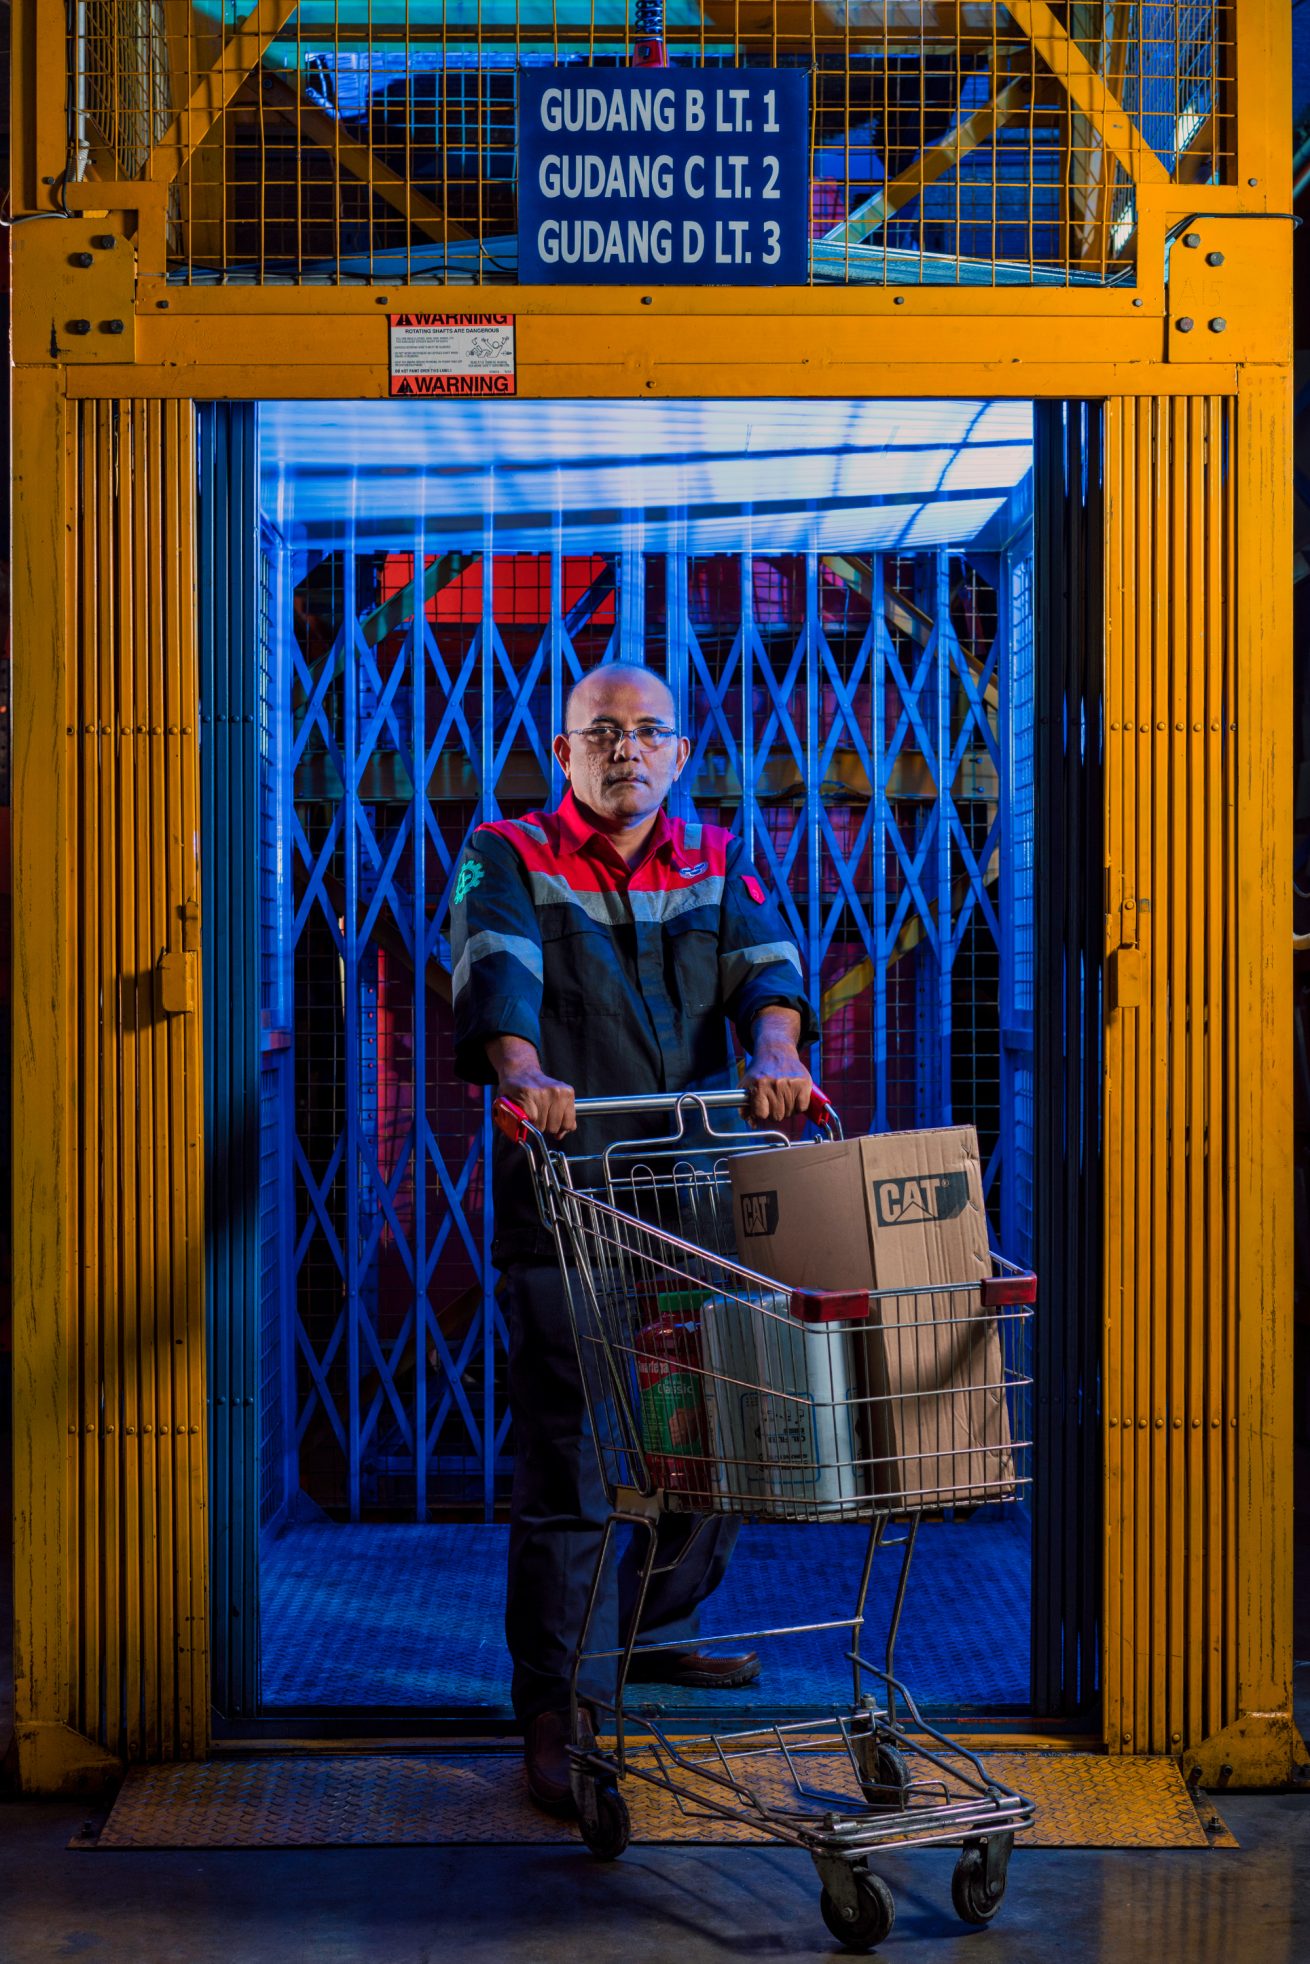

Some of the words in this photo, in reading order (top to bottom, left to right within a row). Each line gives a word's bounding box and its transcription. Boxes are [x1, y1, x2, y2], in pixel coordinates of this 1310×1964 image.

[540, 88, 675, 132] GUDANG
[685, 89, 706, 132] B
[716, 89, 753, 132] LT.
[763, 89, 780, 133] 1
[539, 154, 674, 199] GUDANG
[684, 155, 705, 199] C
[715, 155, 751, 199] LT.
[762, 155, 781, 199] 2
[537, 219, 672, 264] GUDANG
[682, 220, 704, 264] D
[715, 220, 752, 264] LT.
[762, 220, 781, 265] 3
[415, 314, 508, 325] WARNING
[415, 376, 509, 393] WARNING
[742, 1194, 768, 1233] CAT
